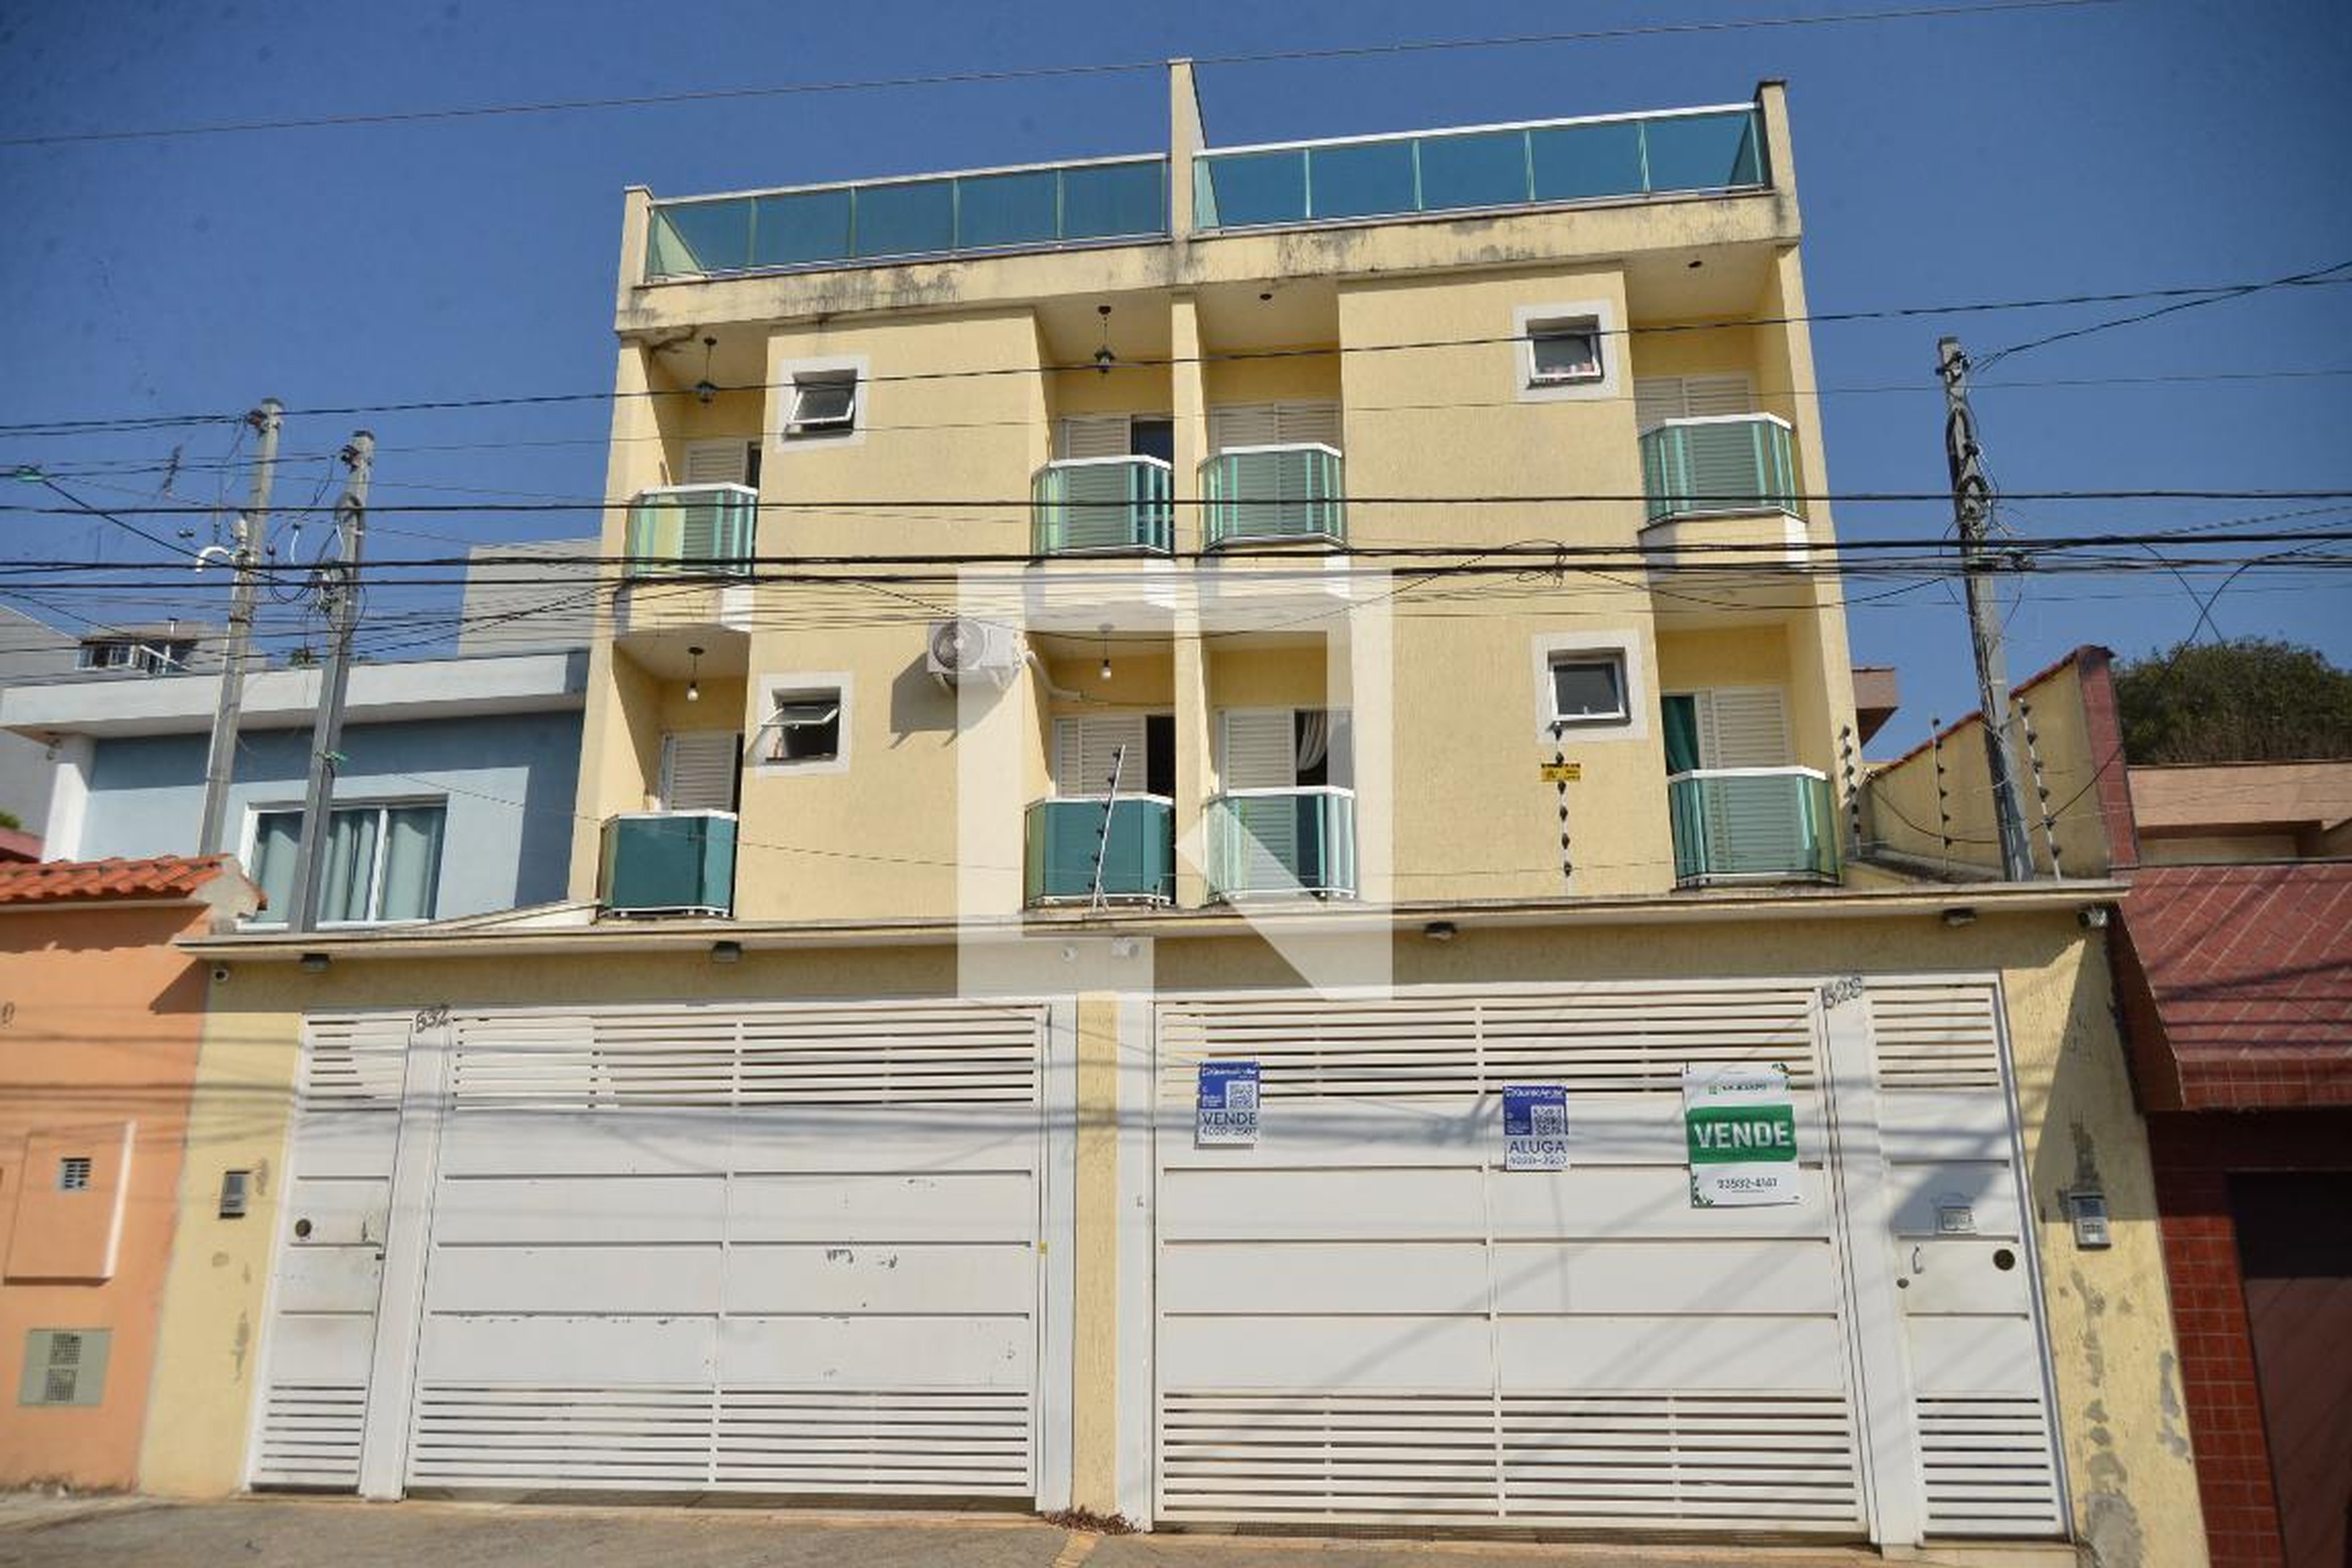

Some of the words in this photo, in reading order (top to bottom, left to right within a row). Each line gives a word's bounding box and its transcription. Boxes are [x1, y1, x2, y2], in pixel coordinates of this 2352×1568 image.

[1202, 1112, 1257, 1126] VENDE
[1694, 1120, 1791, 1148] VENDE
[1509, 1140, 1567, 1154] ALUGA
